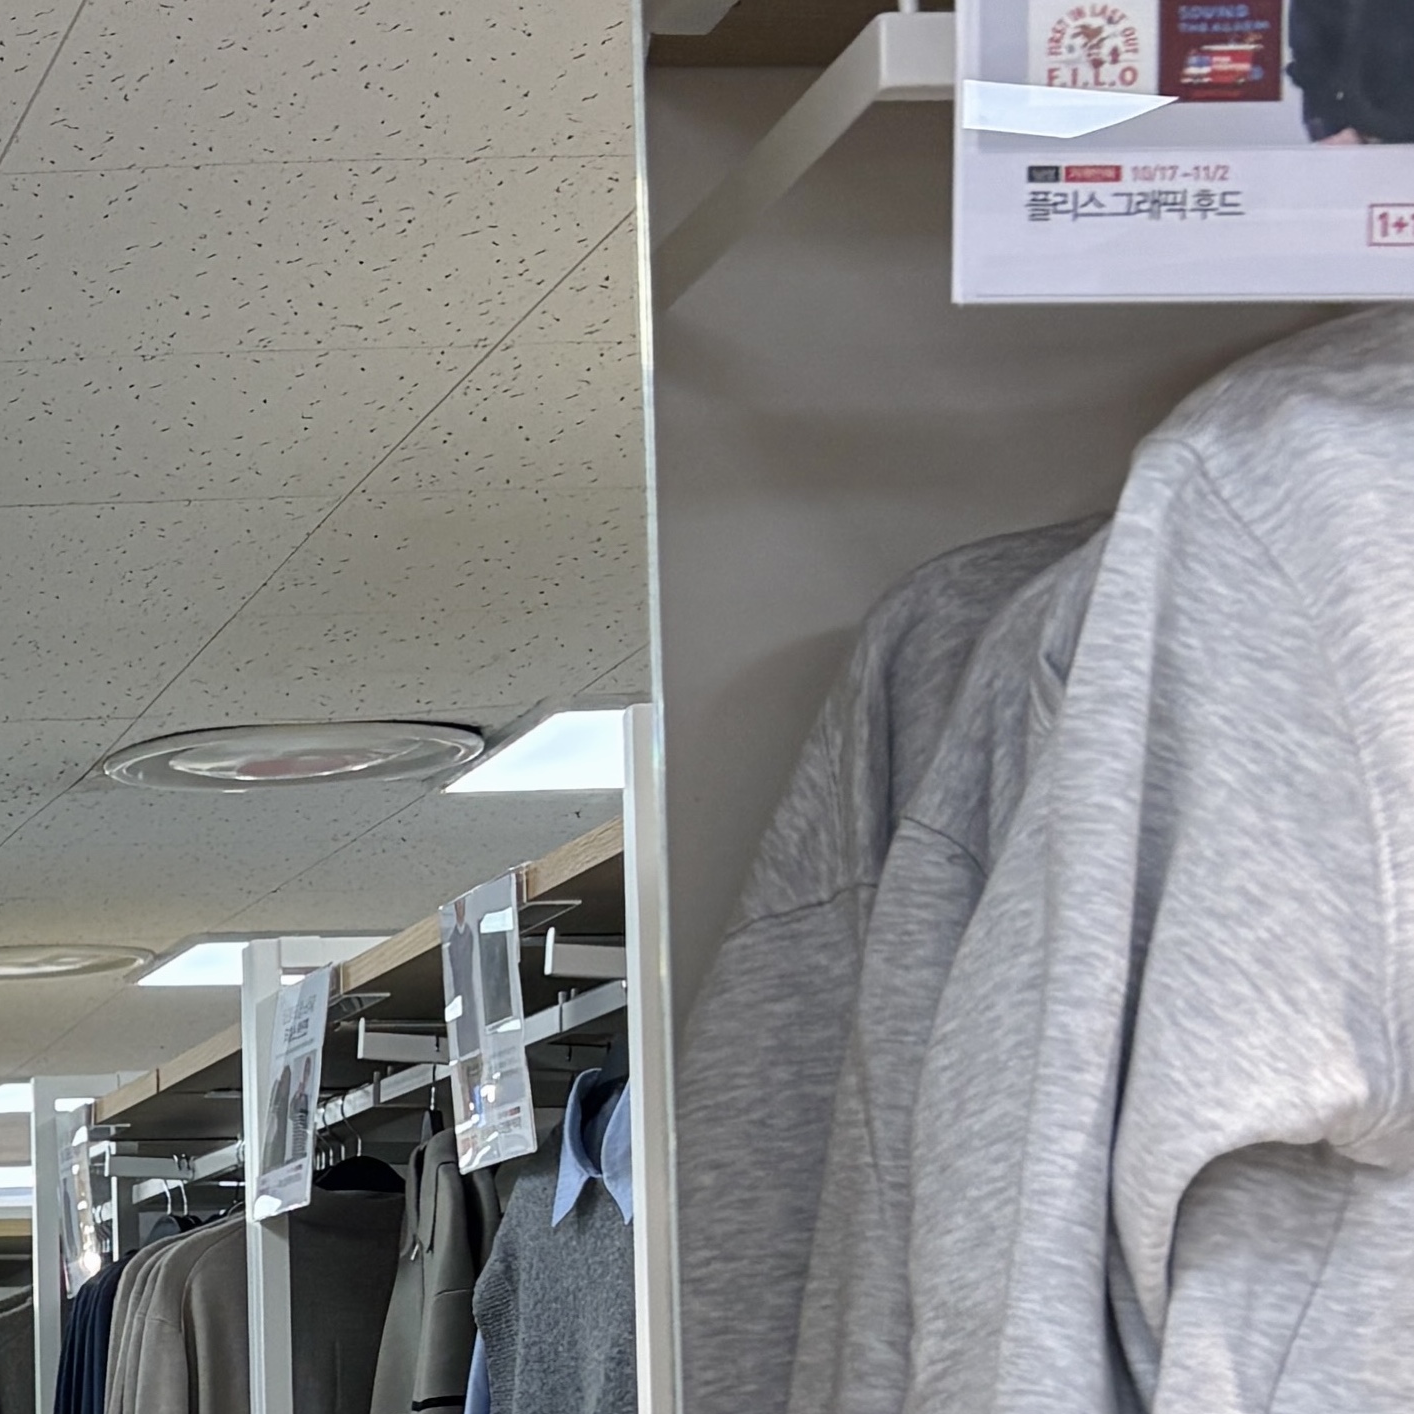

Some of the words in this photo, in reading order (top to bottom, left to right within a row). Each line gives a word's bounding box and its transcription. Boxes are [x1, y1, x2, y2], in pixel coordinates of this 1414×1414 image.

[1025, 189, 1108, 222] 플리스
[1111, 189, 1188, 221] 그래픽
[1189, 189, 1246, 221] 후드
[1378, 211, 1414, 238] 1+
